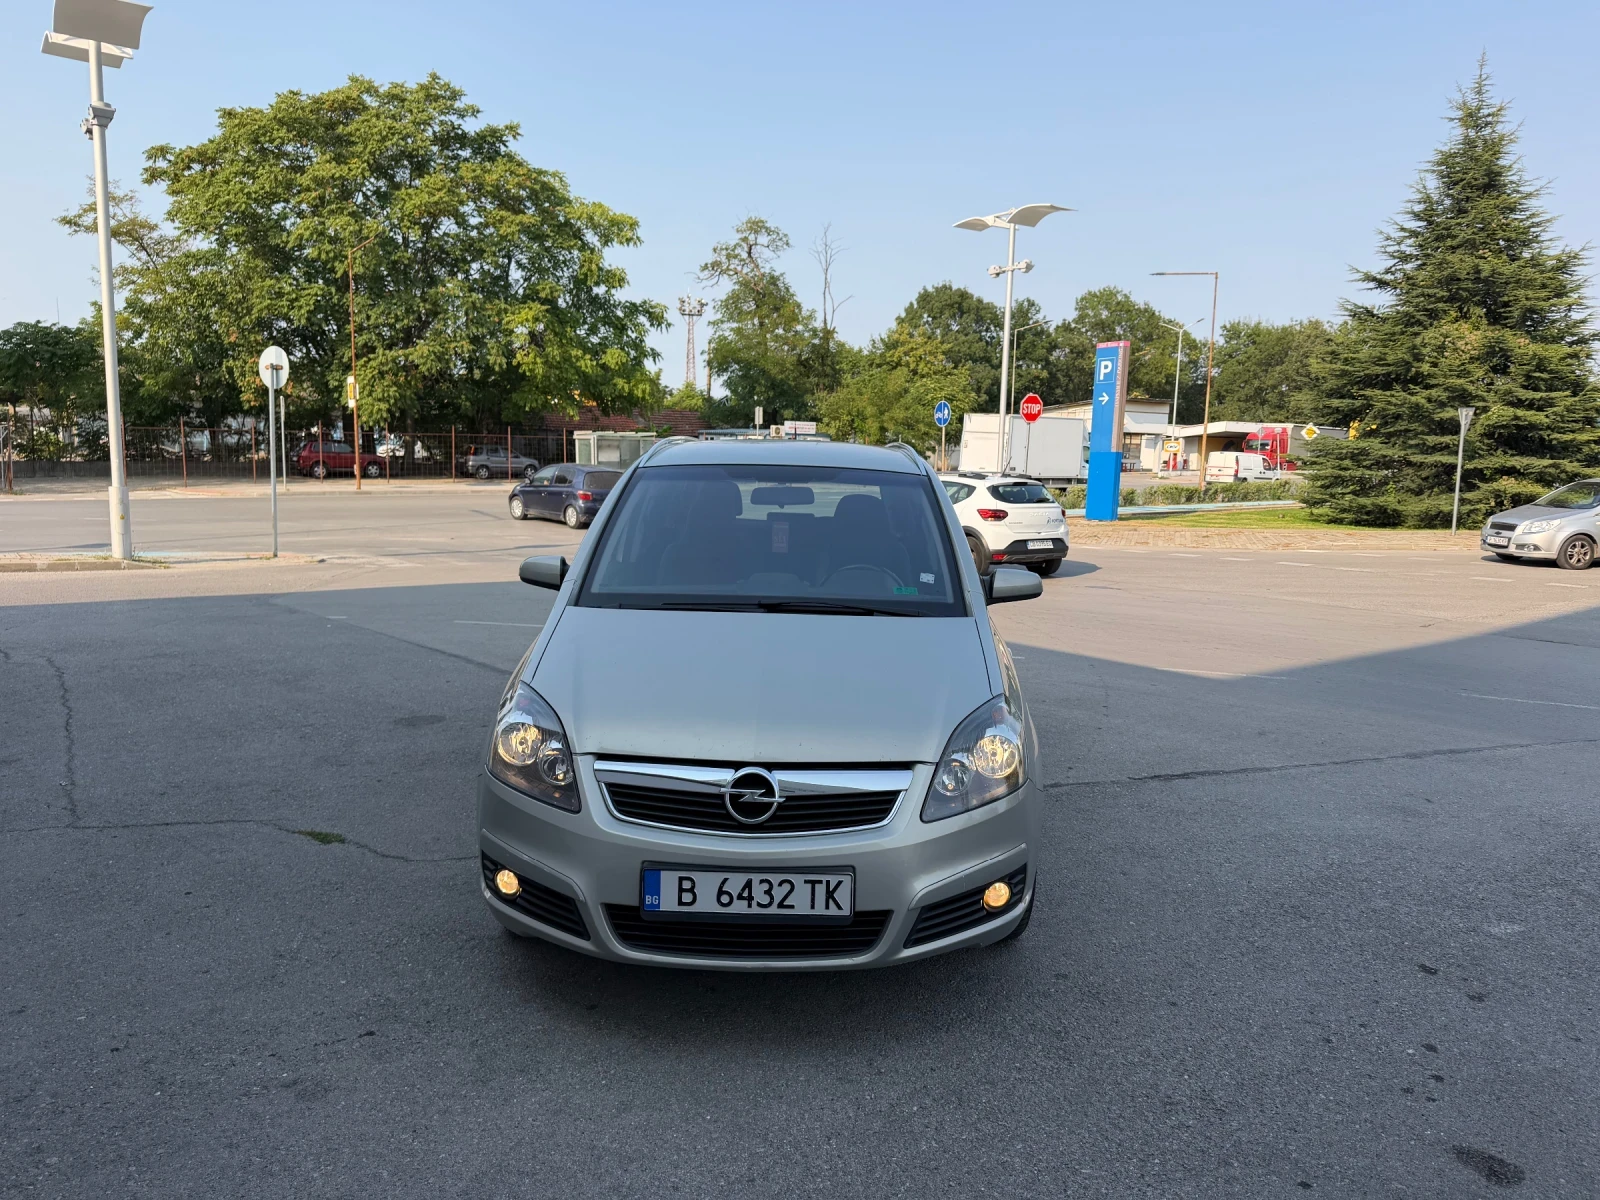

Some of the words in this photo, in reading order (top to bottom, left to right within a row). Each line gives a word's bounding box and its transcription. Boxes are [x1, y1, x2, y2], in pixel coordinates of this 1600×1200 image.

[1099, 360, 1112, 381] P
[1022, 403, 1041, 415] STOP
[645, 895, 659, 905] BG
[677, 875, 698, 907] B
[716, 877, 796, 909] 6432
[803, 879, 844, 911] TK
